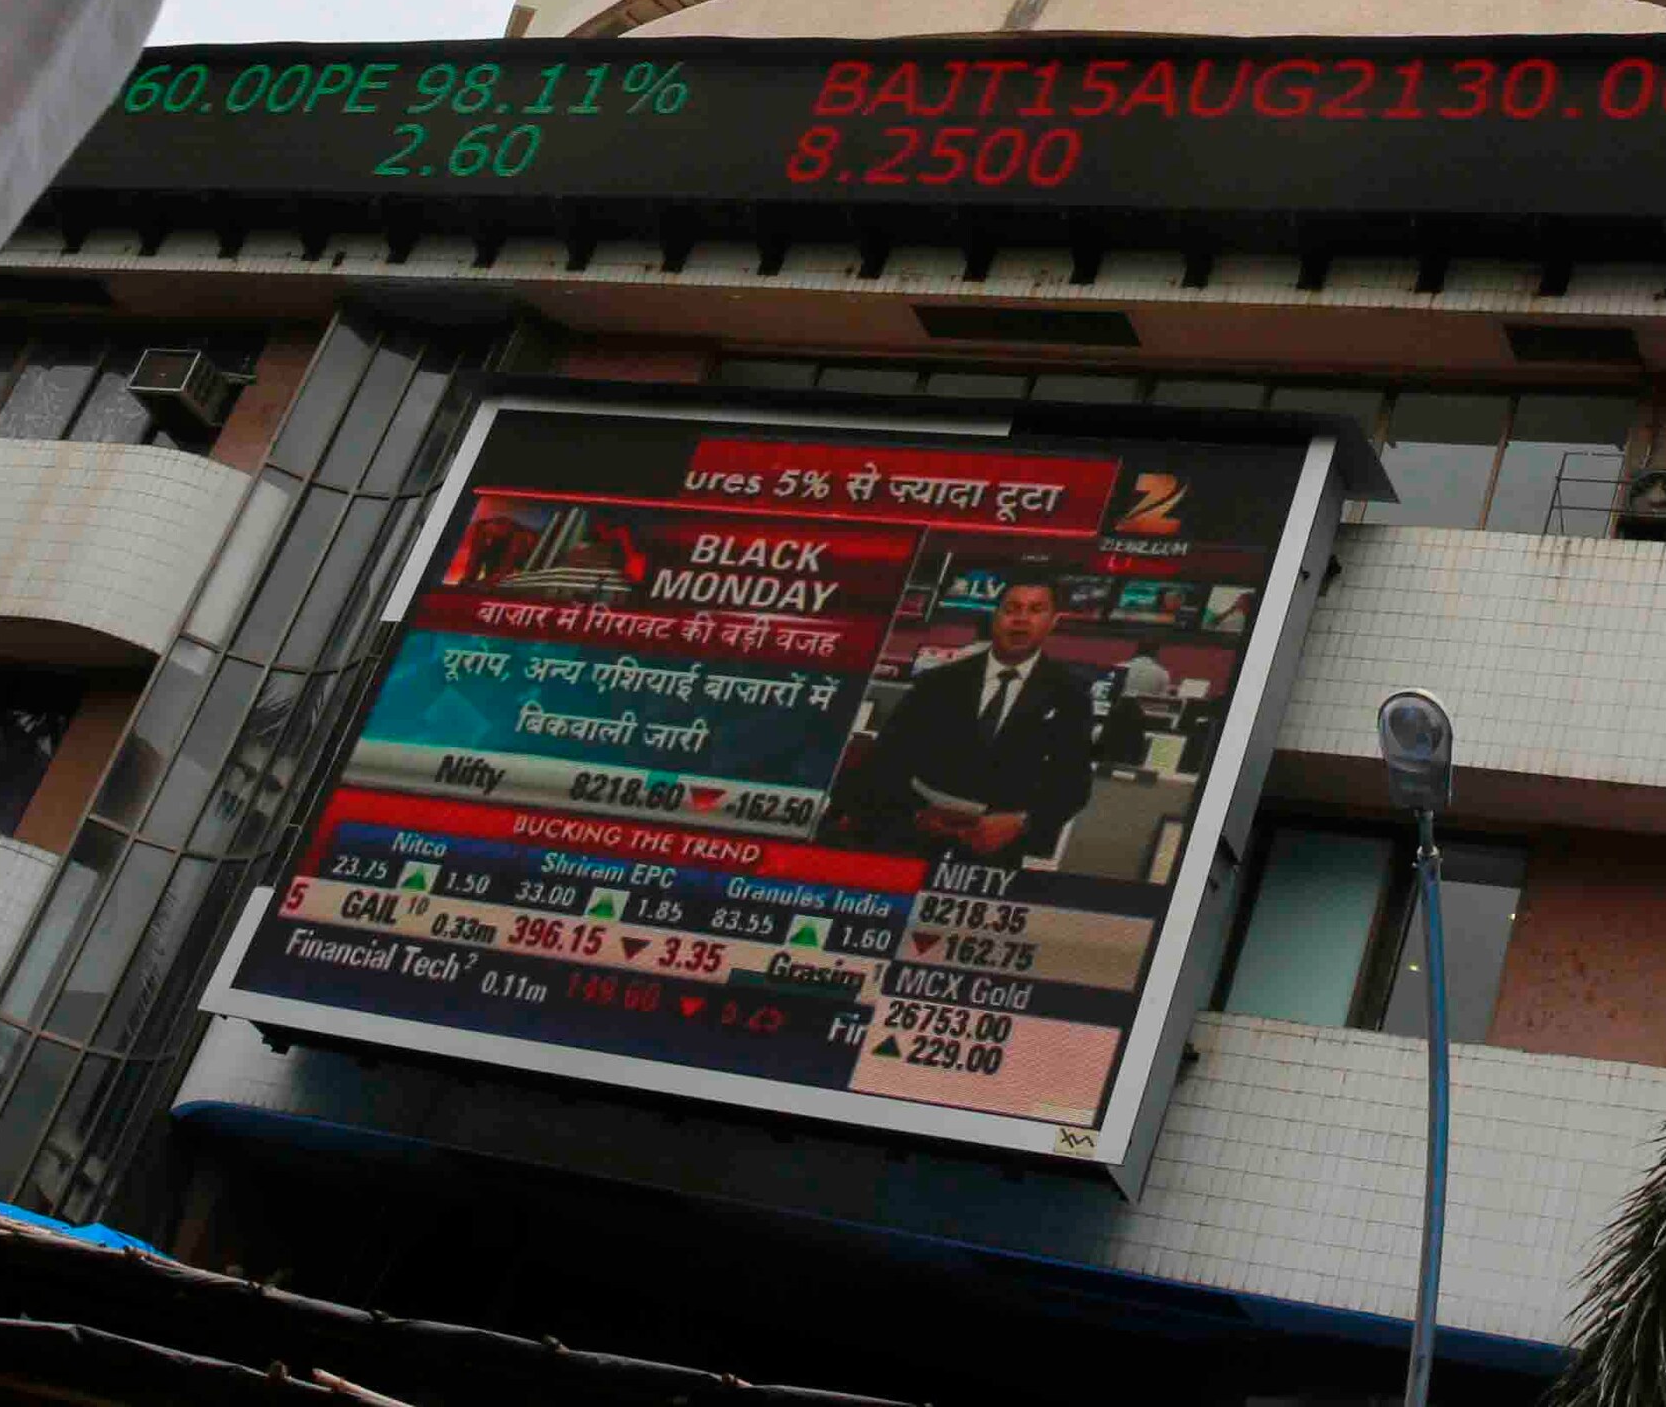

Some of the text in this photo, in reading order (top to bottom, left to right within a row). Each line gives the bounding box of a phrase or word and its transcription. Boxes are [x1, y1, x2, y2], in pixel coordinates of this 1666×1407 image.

[404, 60, 690, 115] 98.11%
[374, 123, 543, 177] 2.60
[784, 126, 1084, 187] 8.2500
[684, 468, 763, 495] ures
[772, 468, 832, 500] 5%
[846, 462, 880, 502] से
[995, 484, 1064, 522] टूटा
[690, 533, 830, 574] BLACK
[651, 568, 840, 614] MONDAY
[556, 602, 583, 633] में
[584, 602, 681, 641] गिरावट
[681, 609, 717, 645] की
[774, 627, 842, 658] वजह
[524, 655, 584, 686] अन्य
[591, 657, 703, 703] एशियाई
[806, 677, 842, 712] में
[515, 699, 710, 754] बिकवाली जारी
[435, 753, 507, 795] Nifty
[569, 770, 687, 813] 8218.60
[390, 831, 448, 858] Nitco
[513, 814, 762, 865] BUCKING THE TREND
[446, 871, 492, 895] 1.50
[541, 851, 680, 890] Shriram EPC
[933, 862, 1019, 897] NIFTY
[515, 880, 684, 923] 33.00 1.85
[726, 876, 893, 918] Granules India
[918, 894, 1030, 935] 8218.35
[286, 882, 309, 911] 5
[341, 889, 399, 926] GAIL
[431, 912, 497, 944] 0.33m
[508, 913, 608, 957] 396.15
[658, 936, 729, 973] 3.35
[769, 950, 865, 988] Grasim
[841, 926, 893, 951] 1.60
[944, 932, 1035, 972] 162.75
[285, 927, 393, 972] Financial
[400, 945, 462, 983] Tech
[481, 970, 548, 1005] 0.11m
[895, 967, 1033, 1012] MCX Gold
[884, 999, 1013, 1044] 26753.00
[906, 1037, 1005, 1076] 229.00
